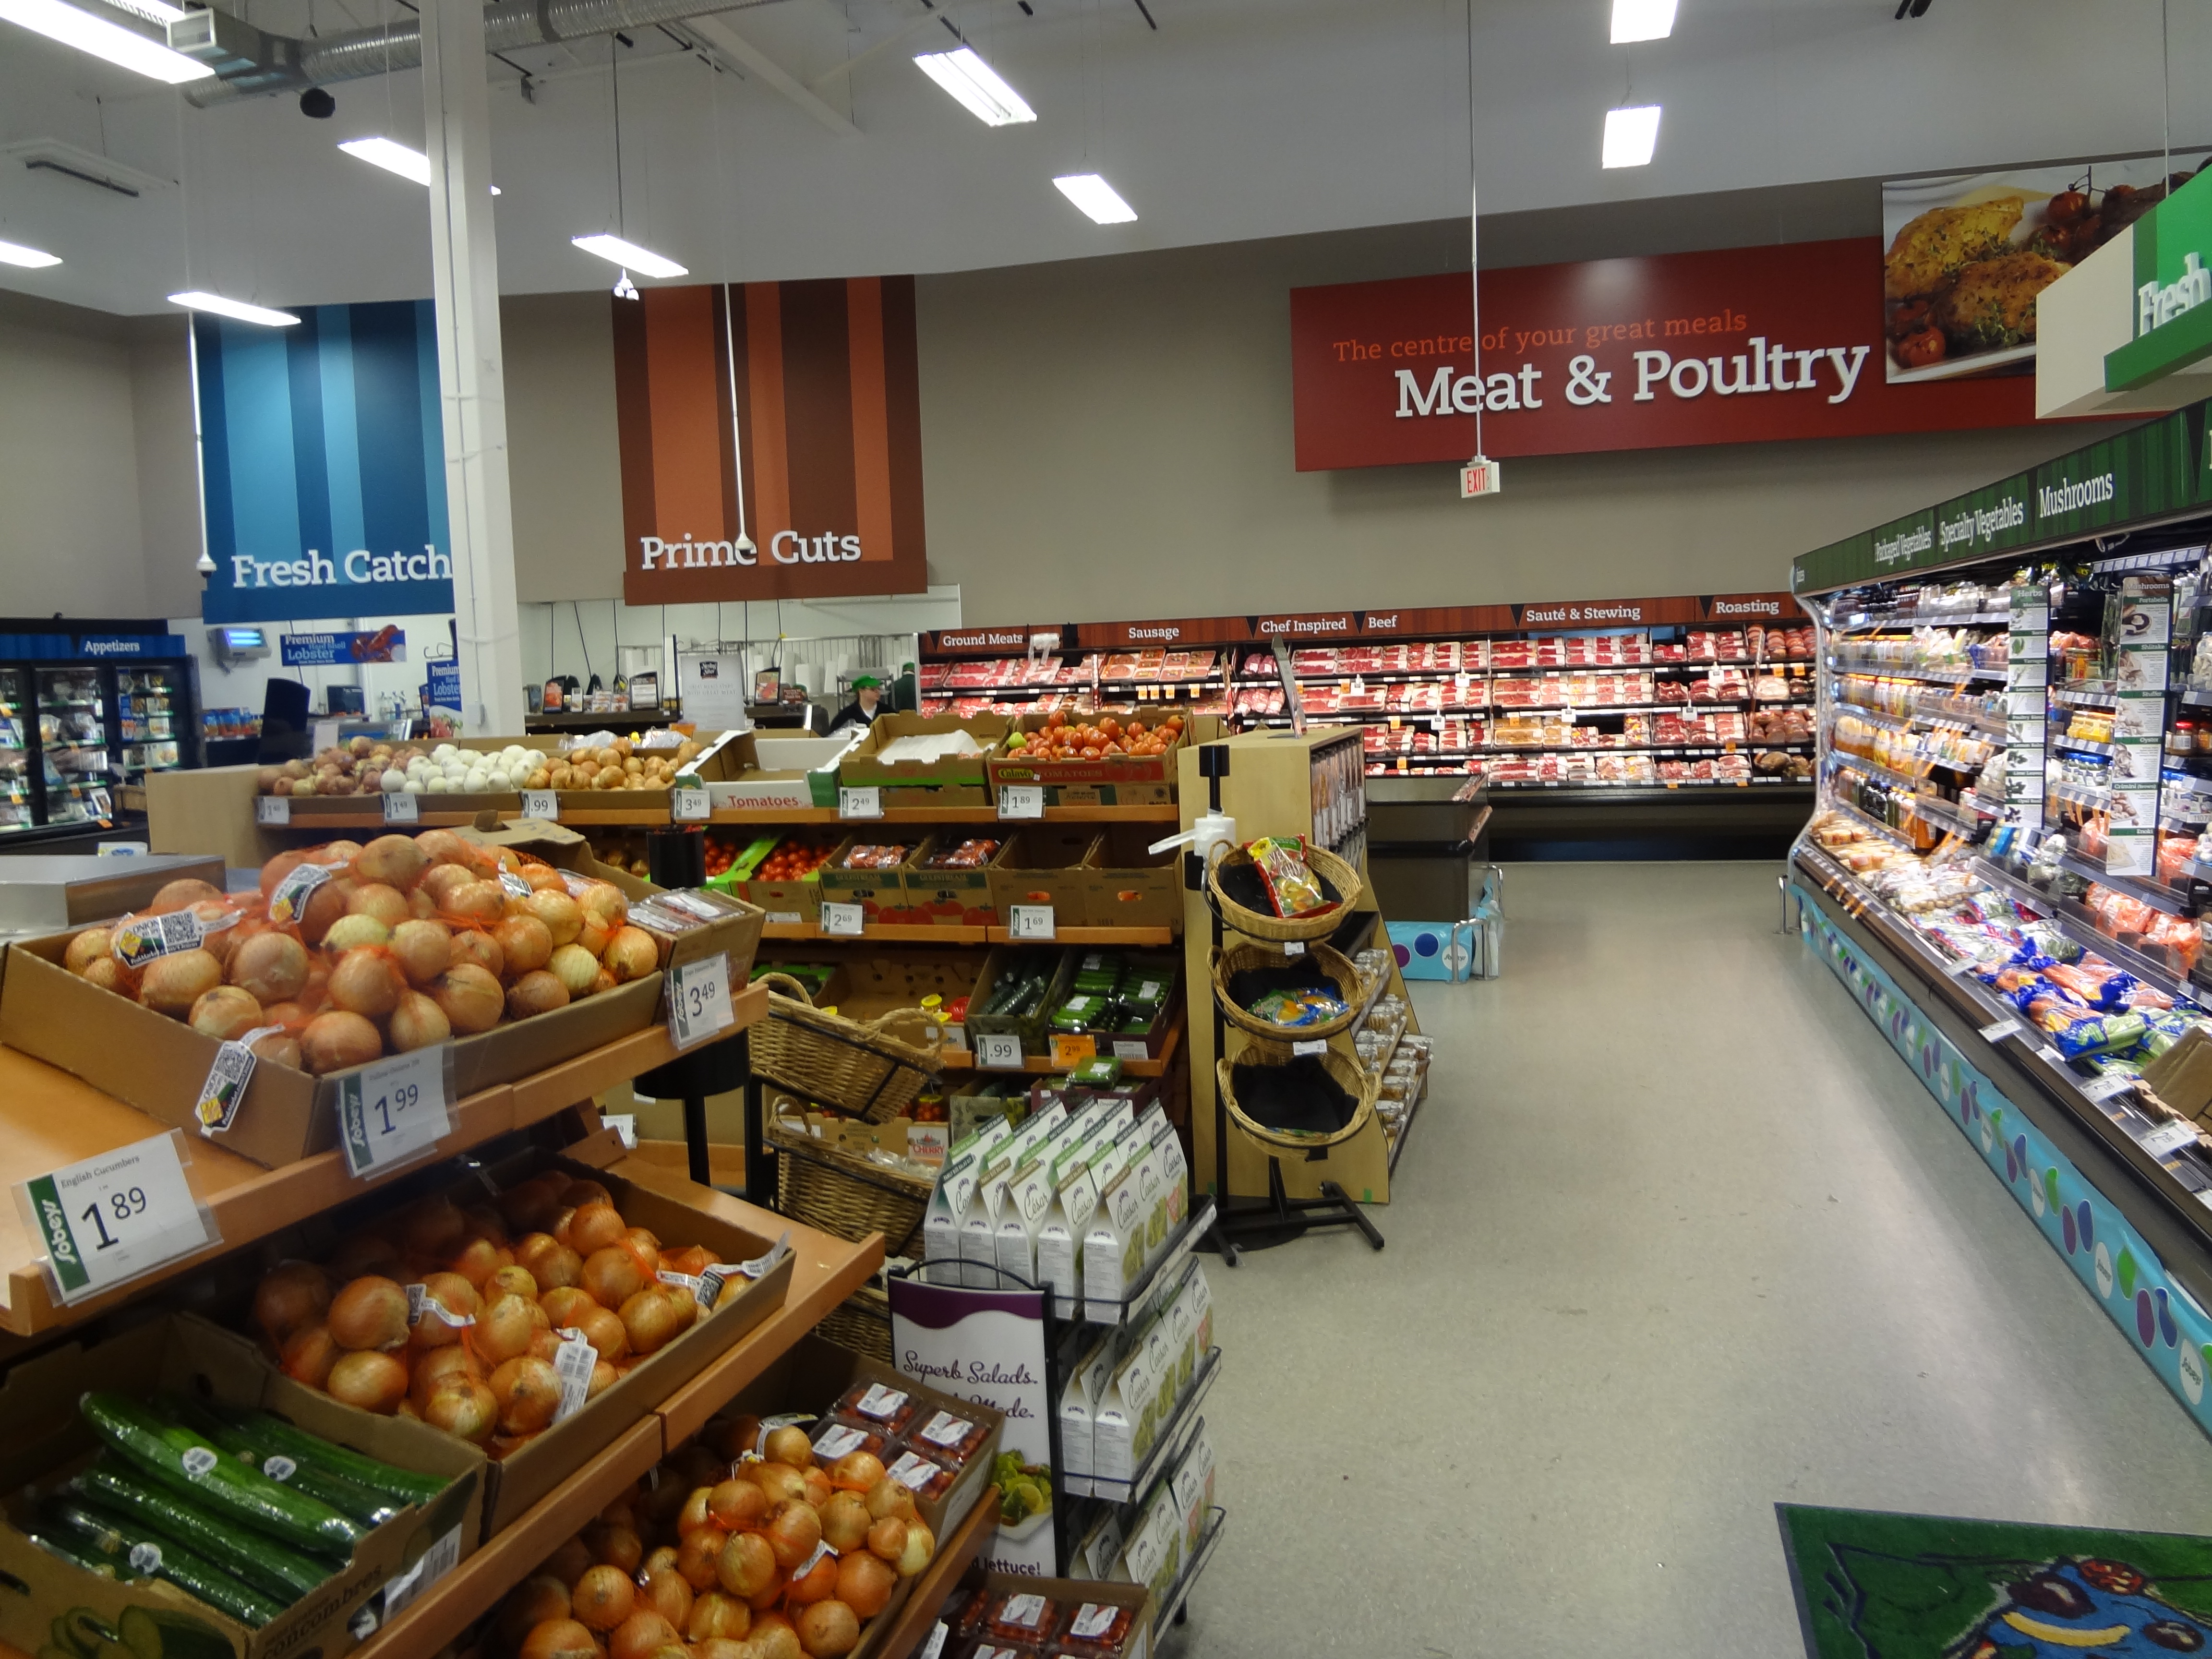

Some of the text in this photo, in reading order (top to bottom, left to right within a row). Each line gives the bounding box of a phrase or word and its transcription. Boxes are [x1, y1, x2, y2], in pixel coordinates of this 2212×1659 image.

[2139, 252, 2212, 337] Fresh
[1334, 309, 1748, 362] The centre of your great meals
[1395, 336, 1871, 419] Meat & Poultry
[1467, 468, 1487, 494] EXIT
[2039, 473, 2113, 518] Mushrooms
[1940, 496, 2024, 552] Specialty Vegetables
[641, 529, 861, 570] Prime Cuts
[1874, 525, 1932, 565] Packaged Vegetables
[231, 544, 453, 588] Fresh Catch
[2017, 589, 2043, 597] Herbs
[1368, 615, 1397, 628] Beef
[1527, 605, 1641, 622] Sauté & Stewing
[1716, 600, 1779, 615] Roasting
[285, 634, 335, 645] Premium
[1129, 627, 1179, 641] Sausage
[1261, 617, 1347, 634] Chef Inspired
[84, 639, 140, 654] Appetizers
[943, 633, 1023, 647] Ground Meats
[288, 648, 335, 661] Lobster
[433, 683, 460, 696] Lobste
[728, 794, 799, 806] Tomatoes
[913, 1143, 945, 1154] CHERRY
[61, 1155, 140, 1190] English Cucumbers
[1164, 1152, 1182, 1178] Caesar
[1139, 1174, 1161, 1202] Caesar
[1024, 1192, 1049, 1221] César
[1071, 1195, 1094, 1225] Caesar
[1117, 1198, 1139, 1230] Caesar
[41, 1199, 78, 1264] Sobeys
[1192, 1285, 1208, 1313] Caesar
[1173, 1313, 1190, 1343] Caesar
[903, 1349, 1038, 1384] Superb Salads.
[1149, 1342, 1170, 1374] Caesar
[969, 1394, 1034, 1419] Mde.
[1129, 1375, 1151, 1410] Caesar
[985, 1557, 1041, 1576] lettuce!
